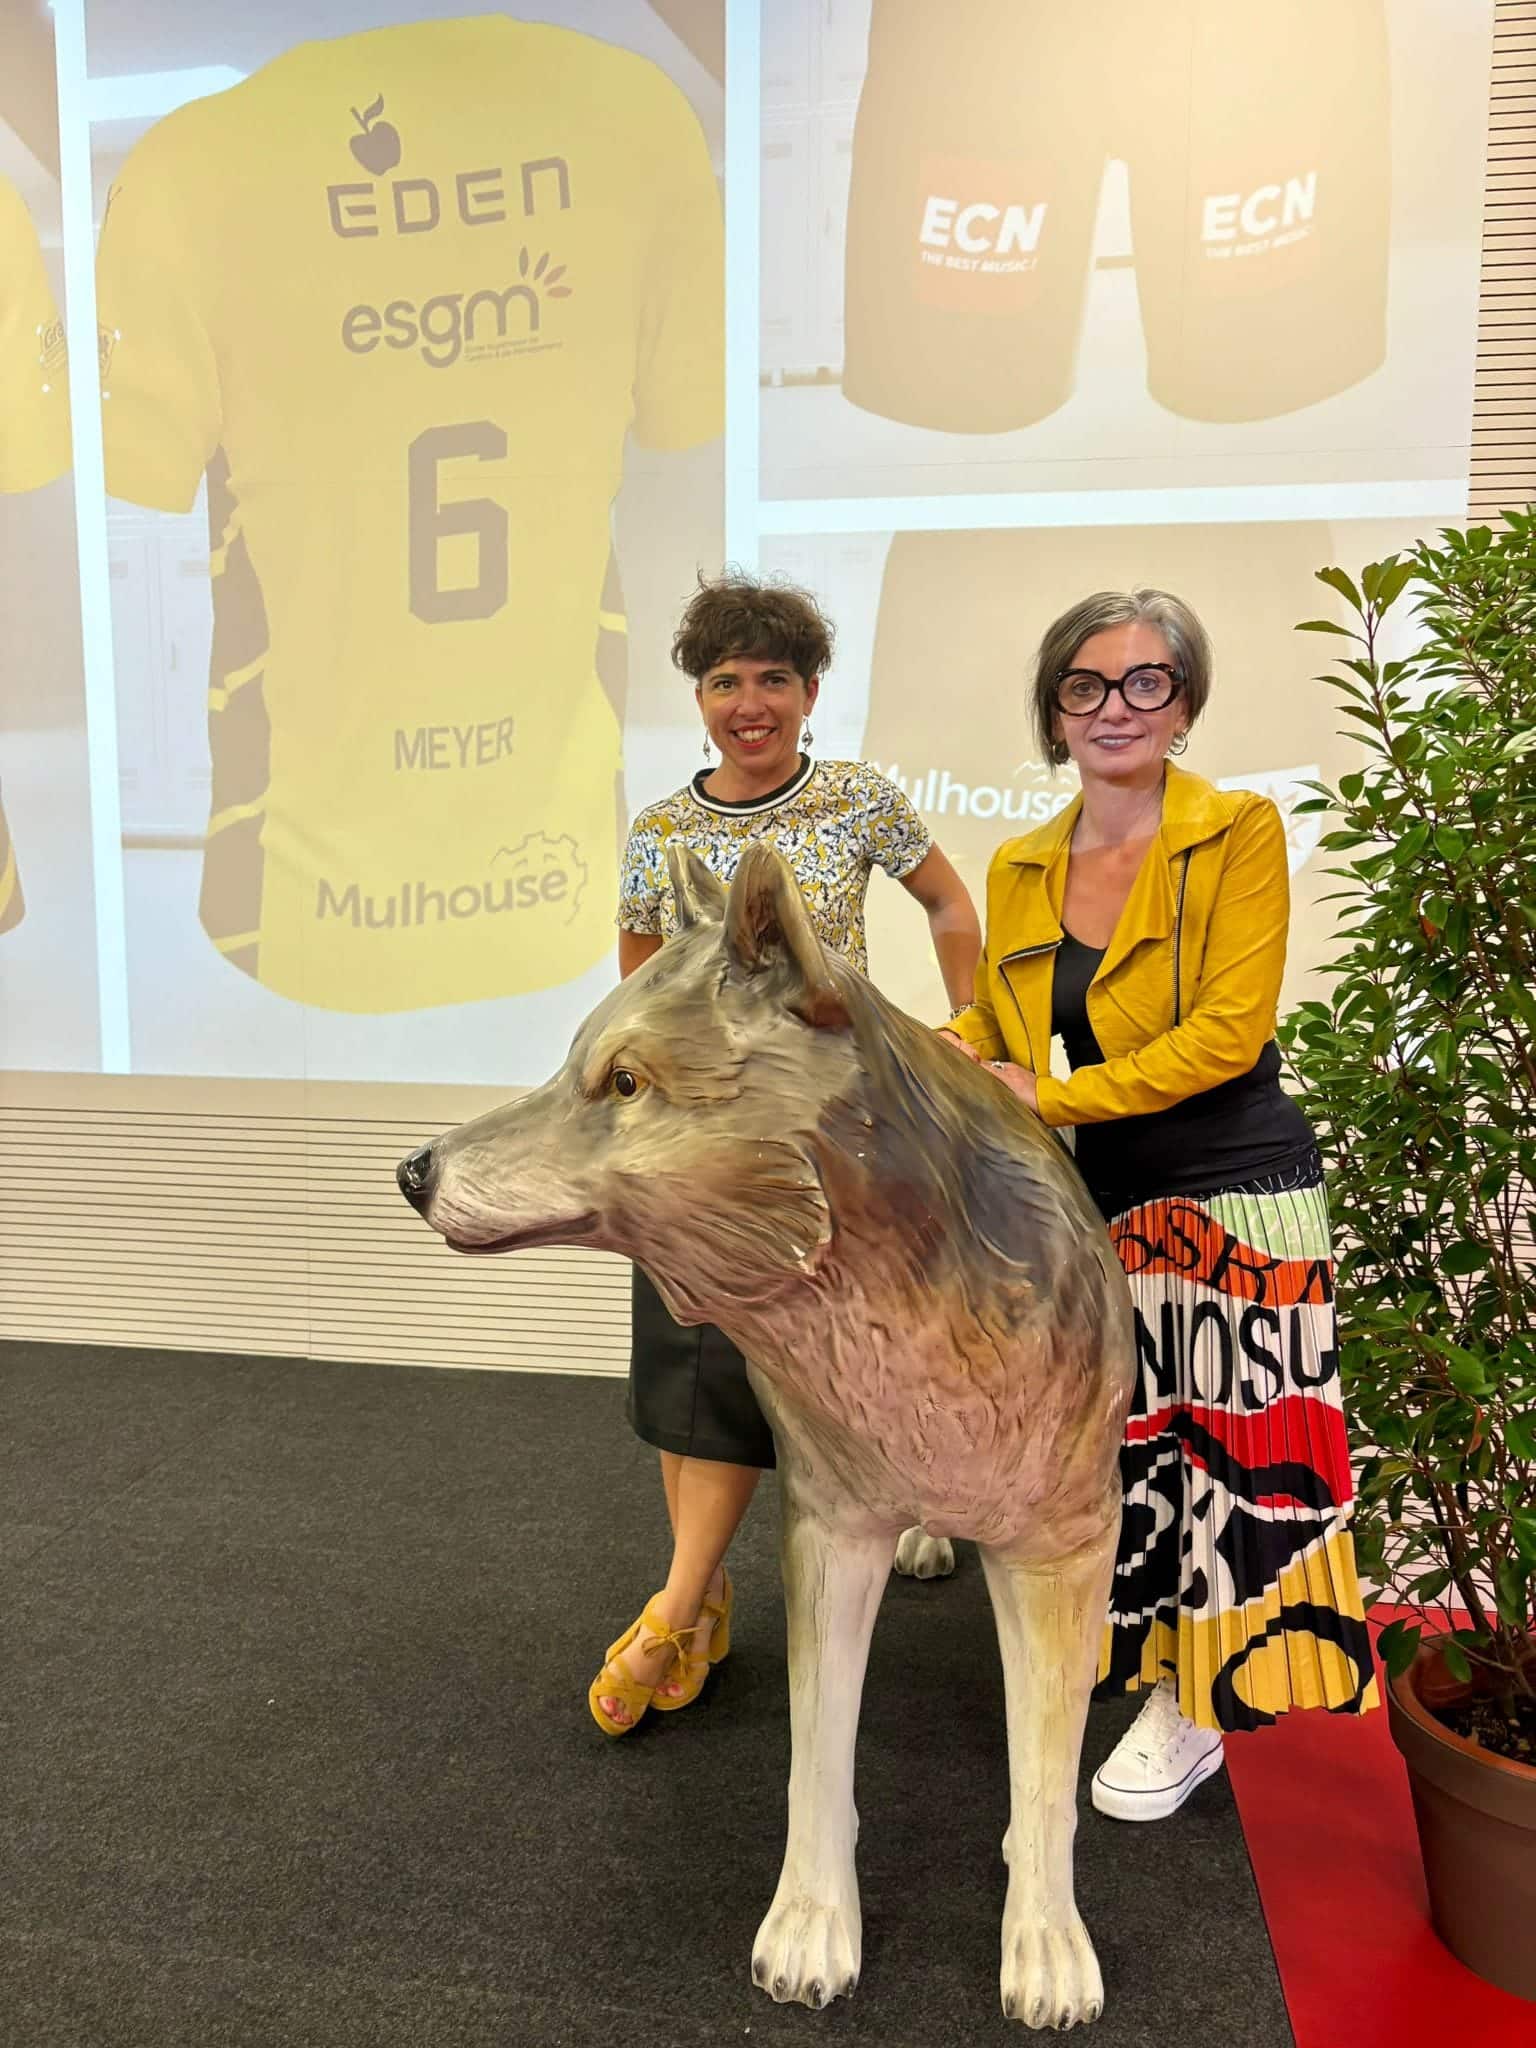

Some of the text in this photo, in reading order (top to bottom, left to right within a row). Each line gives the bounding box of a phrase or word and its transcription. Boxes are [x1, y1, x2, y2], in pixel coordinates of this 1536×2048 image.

[326, 156, 571, 238] EDEN
[919, 195, 1048, 253] ECN
[1200, 171, 1317, 241] ECN
[341, 284, 540, 369] esgm
[408, 420, 508, 625] 6
[394, 716, 514, 771] MEYER
[316, 869, 569, 929] Mulhouse
